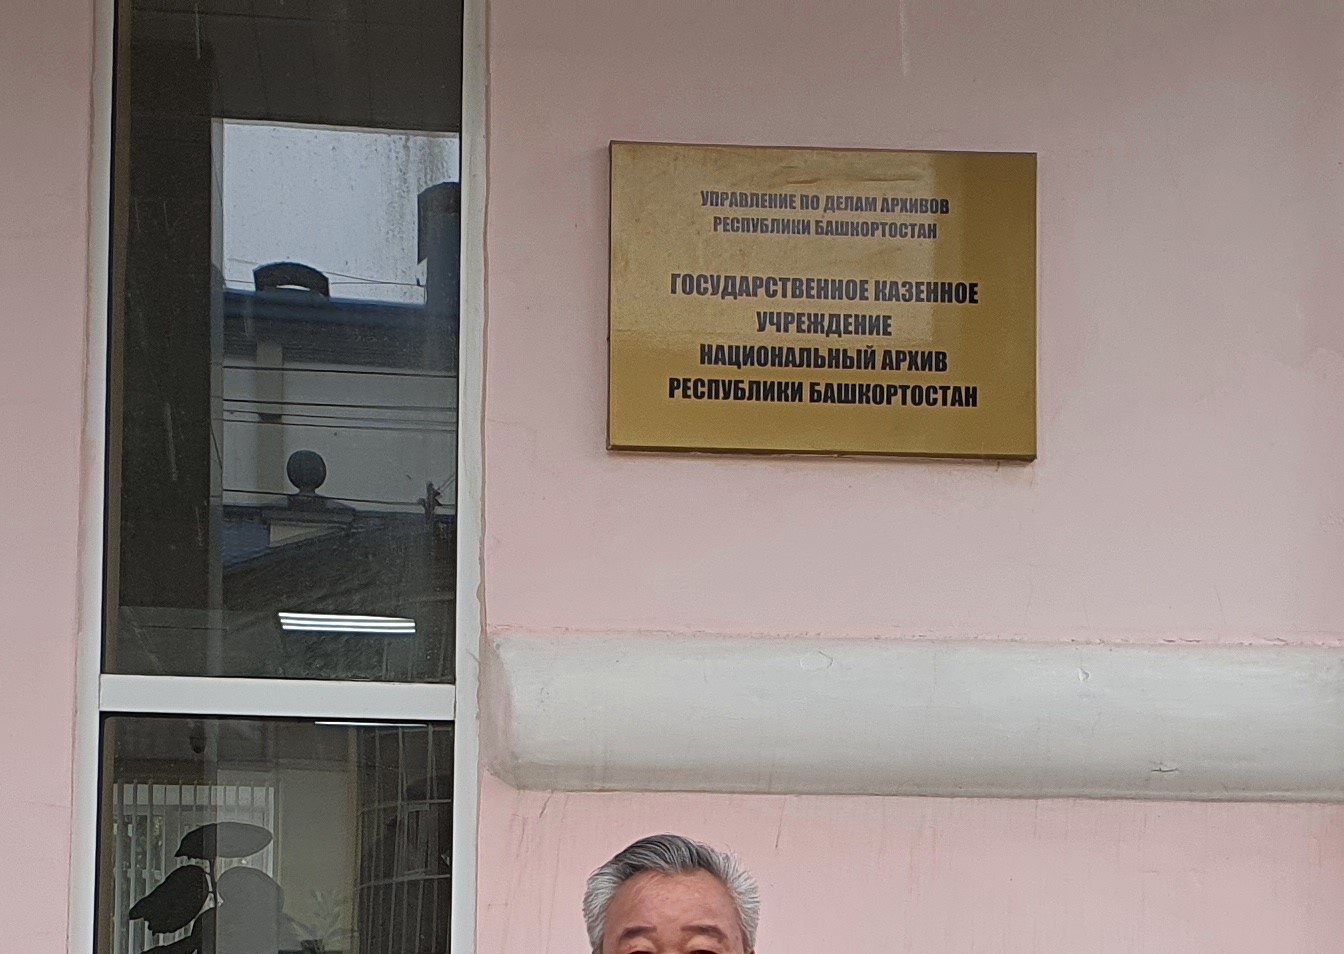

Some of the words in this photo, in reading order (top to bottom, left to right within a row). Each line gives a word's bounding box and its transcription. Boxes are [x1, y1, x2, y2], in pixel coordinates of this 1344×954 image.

[701, 190, 796, 211] УПРАВЛЕНИЕ
[800, 193, 820, 212] ПО
[824, 194, 877, 214] ДЕЛАМ
[881, 196, 950, 215] АРХИВОВ
[713, 216, 811, 236] РЕСПУБЛИКИ
[815, 220, 938, 239] БАШКОРТОСТАН
[670, 273, 869, 301] ГОСУДАРСТВЕННОЕ
[874, 282, 979, 304] КАЗЕННОЕ
[756, 311, 892, 336] УЧРЕЖДЕНИЕ
[700, 344, 876, 371] НАЦИОНАЛЬНЫЙ
[881, 352, 948, 372] АРХИВ
[668, 377, 804, 403] РЕСПУБЛИКИ
[809, 382, 978, 407] БАШКОРТОСТАН
